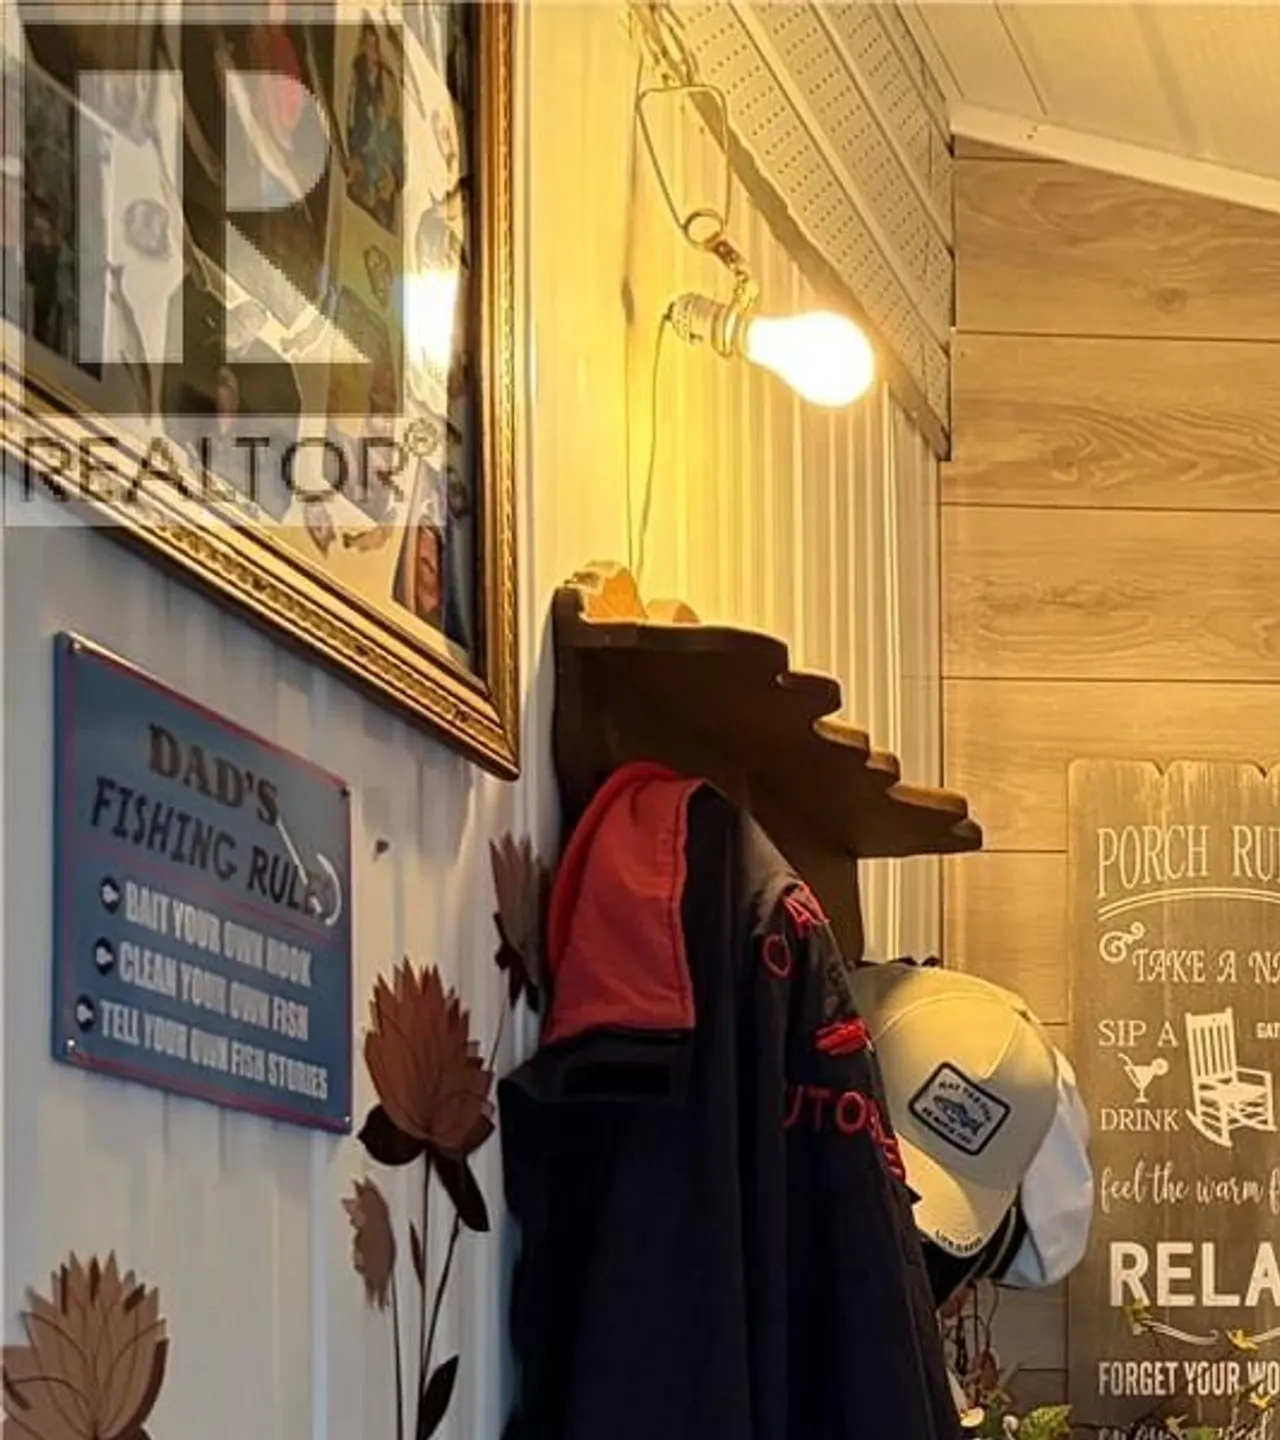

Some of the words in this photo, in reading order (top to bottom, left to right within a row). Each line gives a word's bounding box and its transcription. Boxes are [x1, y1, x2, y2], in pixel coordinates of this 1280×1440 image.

[148, 721, 279, 827] DAD'S
[90, 776, 238, 882] FISHING
[1096, 824, 1210, 900] PORCH
[124, 880, 169, 936] BAIT
[171, 899, 221, 955] YOUR
[118, 940, 177, 998] CLEAN
[179, 960, 228, 1017] YOUR
[271, 995, 309, 1042] FISH
[1132, 947, 1206, 984] TAKE
[1216, 949, 1238, 984] A
[99, 1000, 140, 1047] TELL
[143, 1011, 188, 1061] YOUR
[1098, 1019, 1147, 1048] SIP
[1156, 1020, 1180, 1048] A
[1100, 1108, 1181, 1132] DRINK
[1100, 1160, 1147, 1214] feel
[1145, 1160, 1190, 1206] the
[1196, 1172, 1263, 1206] warm
[1098, 1360, 1178, 1396] FORGET
[1182, 1360, 1240, 1397] YOUR
